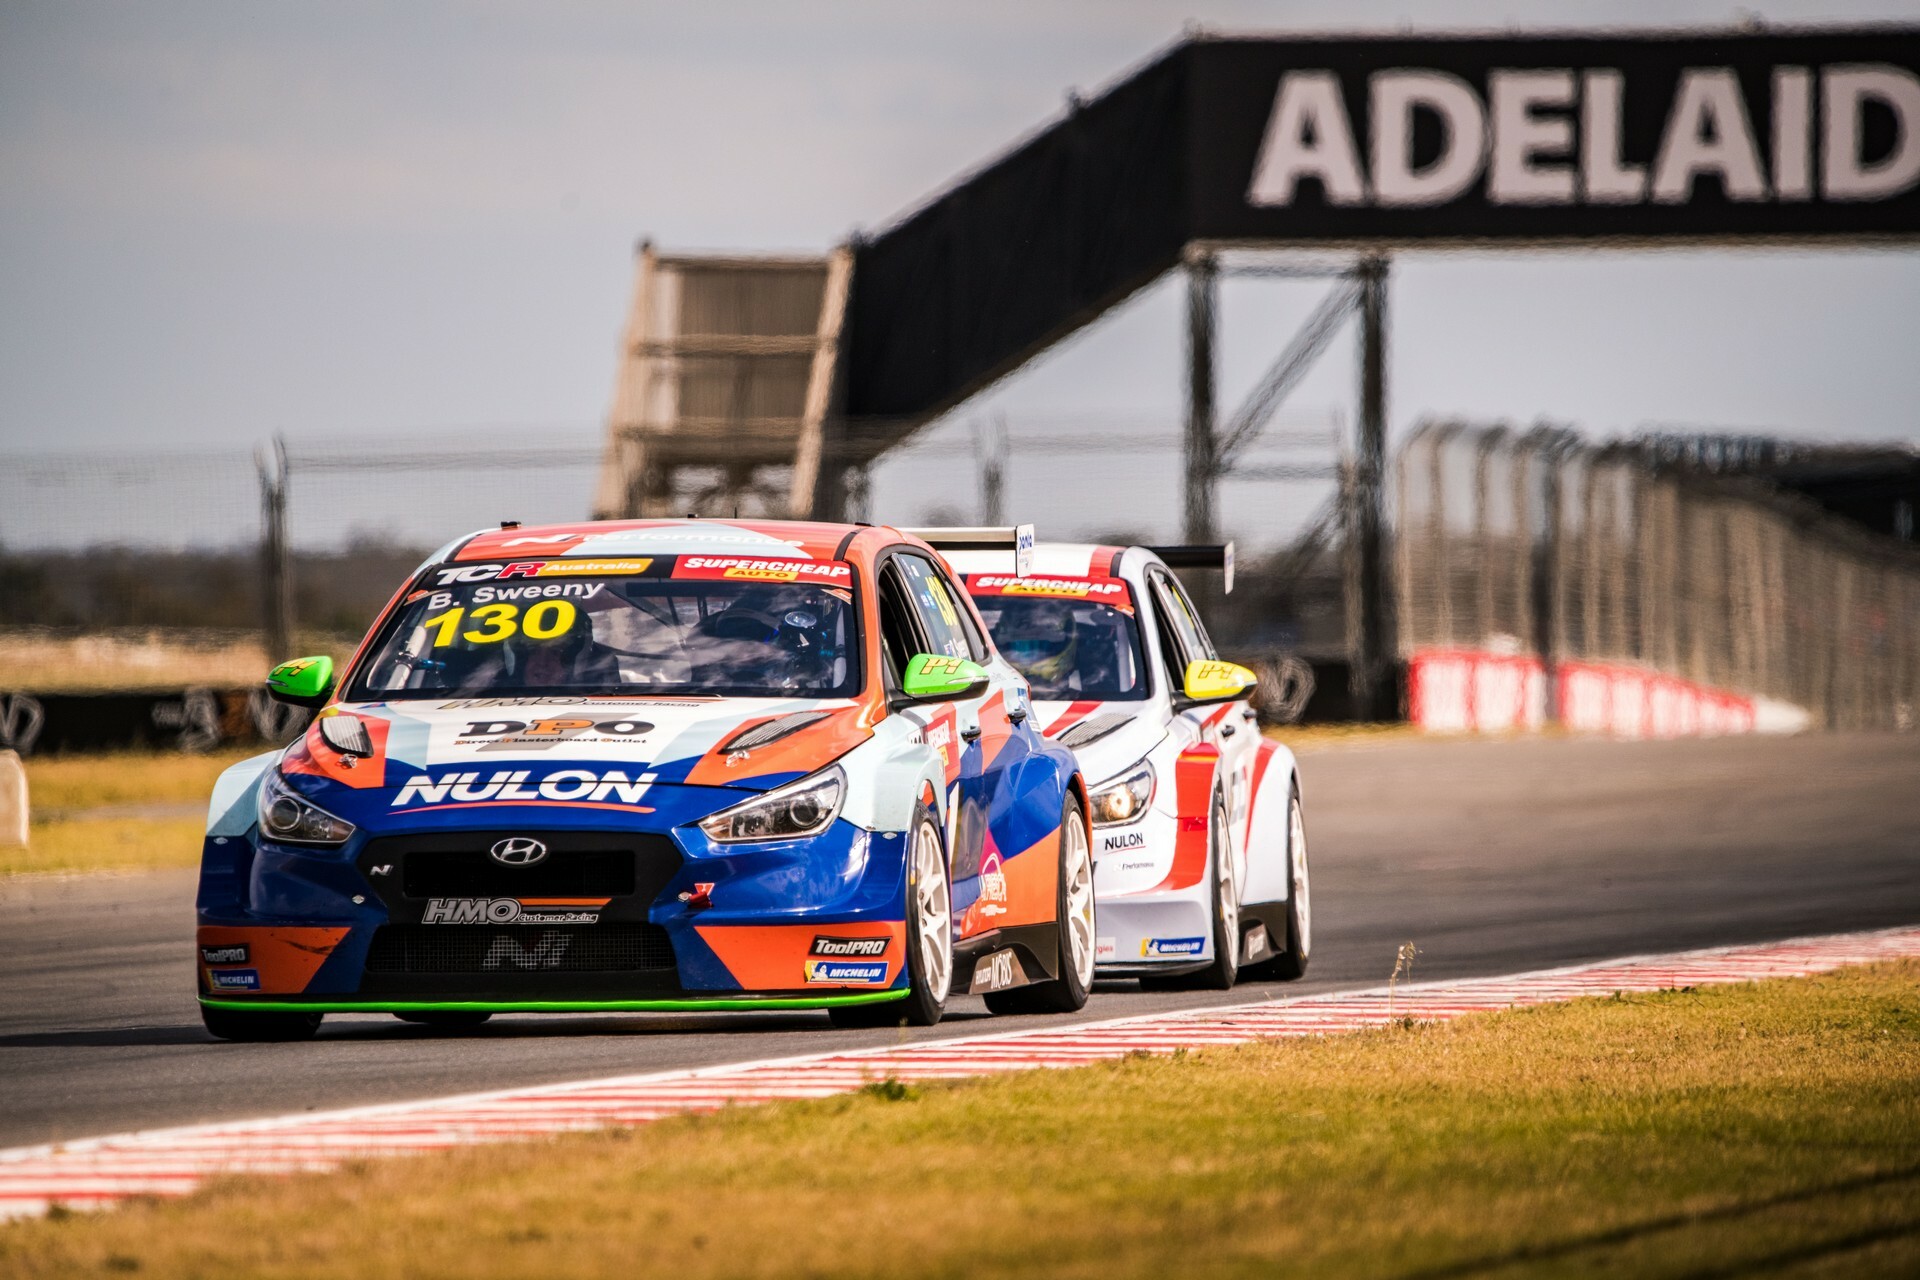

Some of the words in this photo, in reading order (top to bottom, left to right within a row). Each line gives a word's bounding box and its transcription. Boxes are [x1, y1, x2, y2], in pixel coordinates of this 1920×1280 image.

[1245, 62, 1920, 208] ADELAID
[437, 562, 547, 586] TCR
[547, 562, 642, 572] Australia
[684, 557, 850, 577] SUPERCHEAP
[732, 570, 789, 578] AUTO
[976, 576, 1122, 594] SUPERCHEAP
[427, 592, 460, 610] B.
[472, 583, 605, 604] Sweeny
[424, 599, 577, 648] 130
[919, 658, 964, 675] P1
[458, 719, 656, 737] DPO
[390, 769, 658, 807] NULON
[1104, 832, 1144, 850] NULON
[421, 897, 522, 924] HMO
[518, 913, 565, 922] Customer
[566, 912, 599, 924] Racing
[201, 948, 246, 962] ToolPRO
[814, 939, 886, 955] ToolPRO
[1159, 941, 1201, 952] MICHELIN
[219, 975, 255, 984] MICHELIN
[829, 967, 883, 978] MICHELIN
[991, 951, 1013, 990] MOBIS
